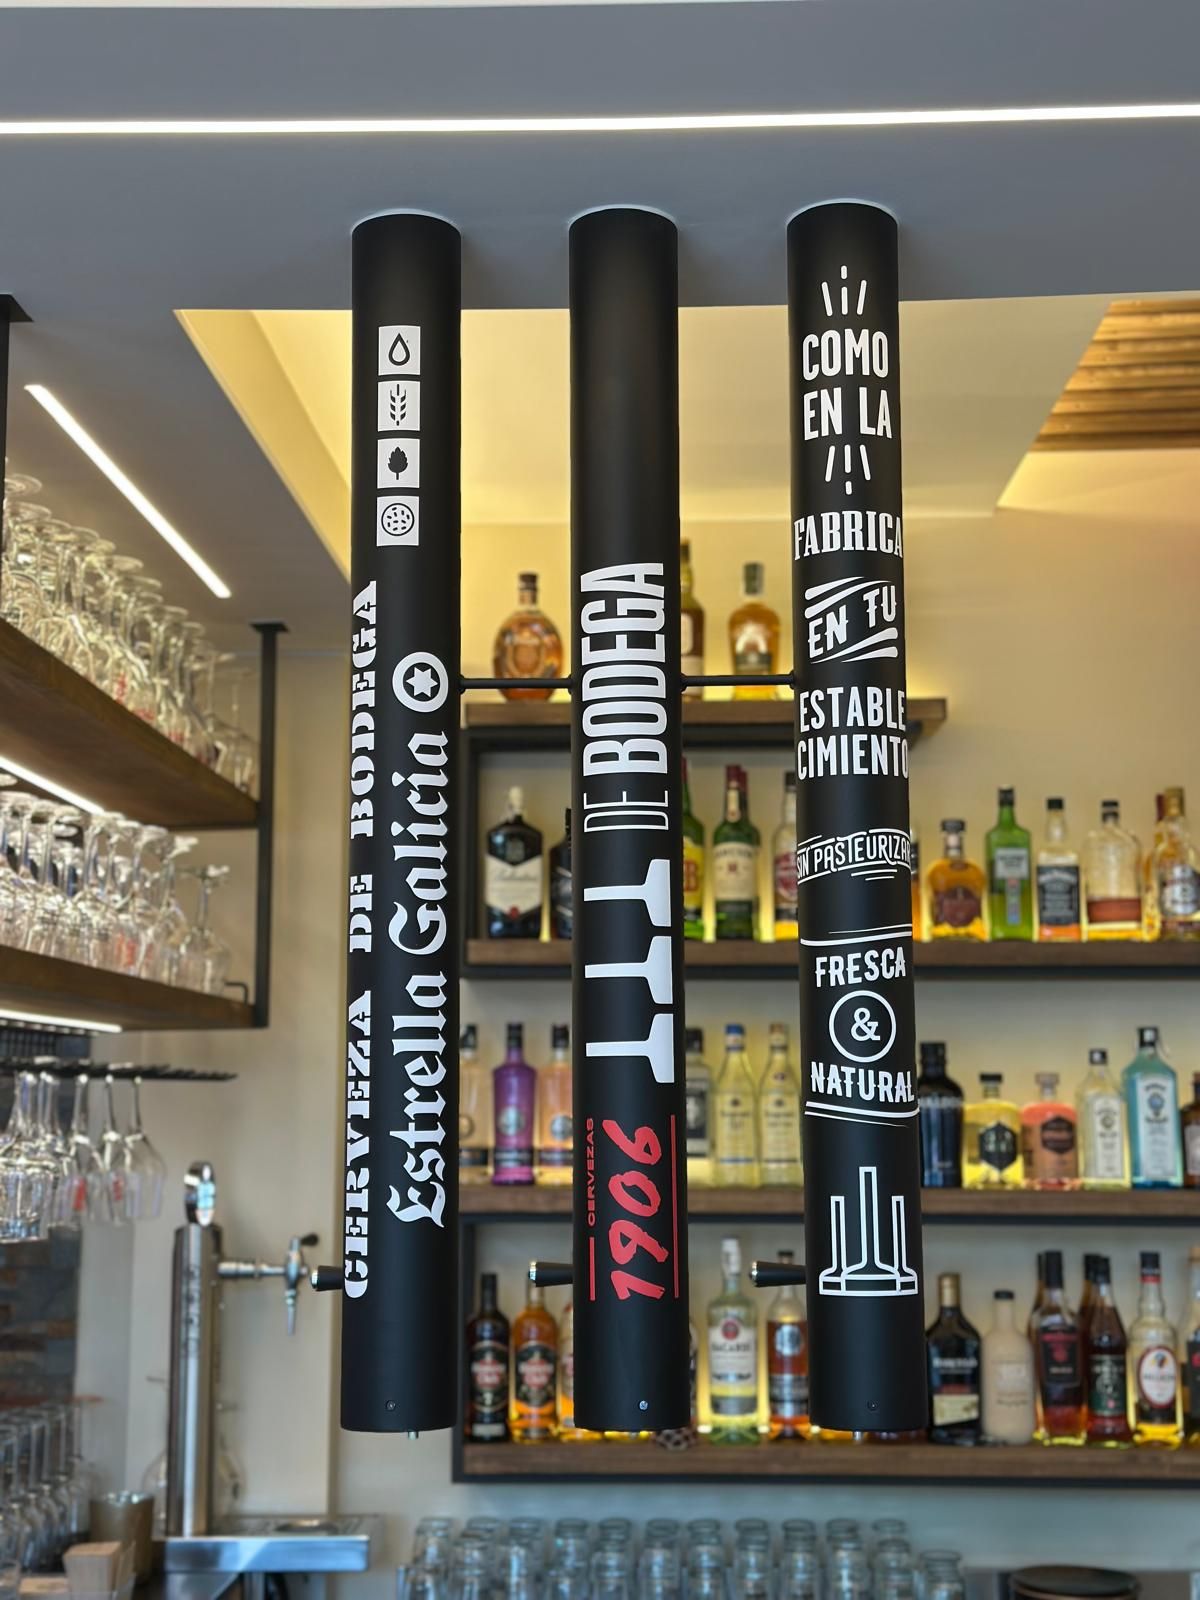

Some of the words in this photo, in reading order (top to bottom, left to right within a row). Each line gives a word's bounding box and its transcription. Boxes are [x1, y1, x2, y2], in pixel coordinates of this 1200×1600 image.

[802, 328, 889, 381] COMO
[803, 386, 843, 441] EN
[858, 386, 893, 439] LA
[793, 510, 904, 561] FABRICA
[808, 604, 849, 659] EN
[862, 585, 897, 628] TU
[580, 562, 668, 777] BODEGA
[350, 580, 377, 840] BODEGA
[799, 686, 906, 733] ESTABLE
[797, 733, 909, 780] CIMIENTO
[583, 790, 669, 833] DE
[388, 730, 449, 955] Galicia
[797, 846, 810, 879] SIN
[349, 874, 373, 953] DE
[815, 946, 907, 988] FRESCA
[850, 1007, 881, 1042] &
[386, 970, 448, 1228] Estrella
[811, 1061, 915, 1103] NATURAL
[344, 990, 372, 1299] CERVEZA
[586, 1117, 597, 1228] CERVEZAS
[602, 1119, 669, 1301] 1906
